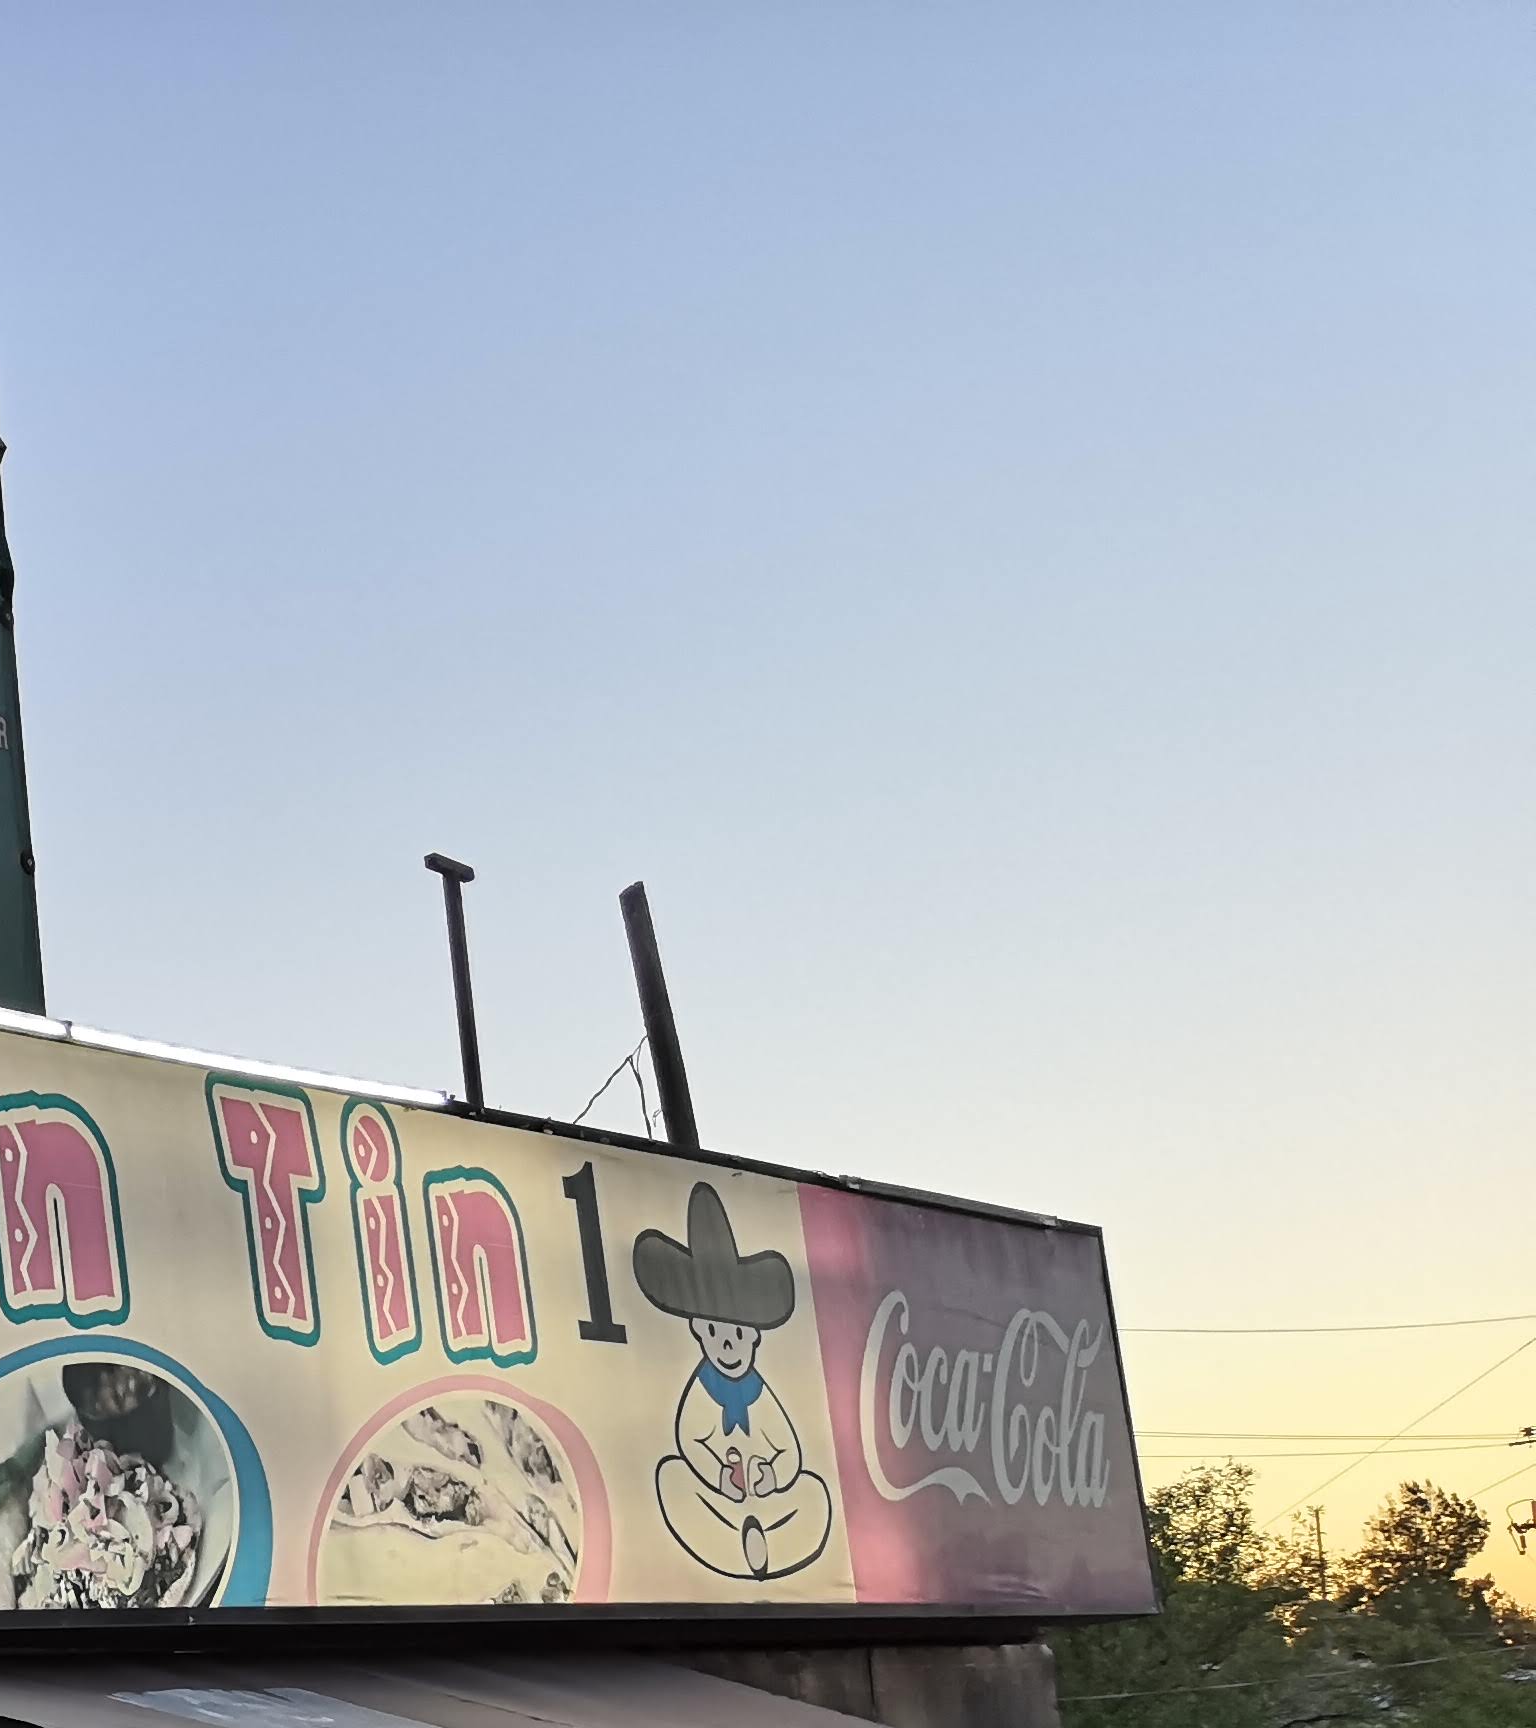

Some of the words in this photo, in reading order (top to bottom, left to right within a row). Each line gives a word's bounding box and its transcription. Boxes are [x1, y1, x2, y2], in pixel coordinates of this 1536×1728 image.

[205, 1070, 538, 1369] Tin
[561, 1160, 628, 1345] 1
[859, 1288, 1111, 1509] Coca-Cola
